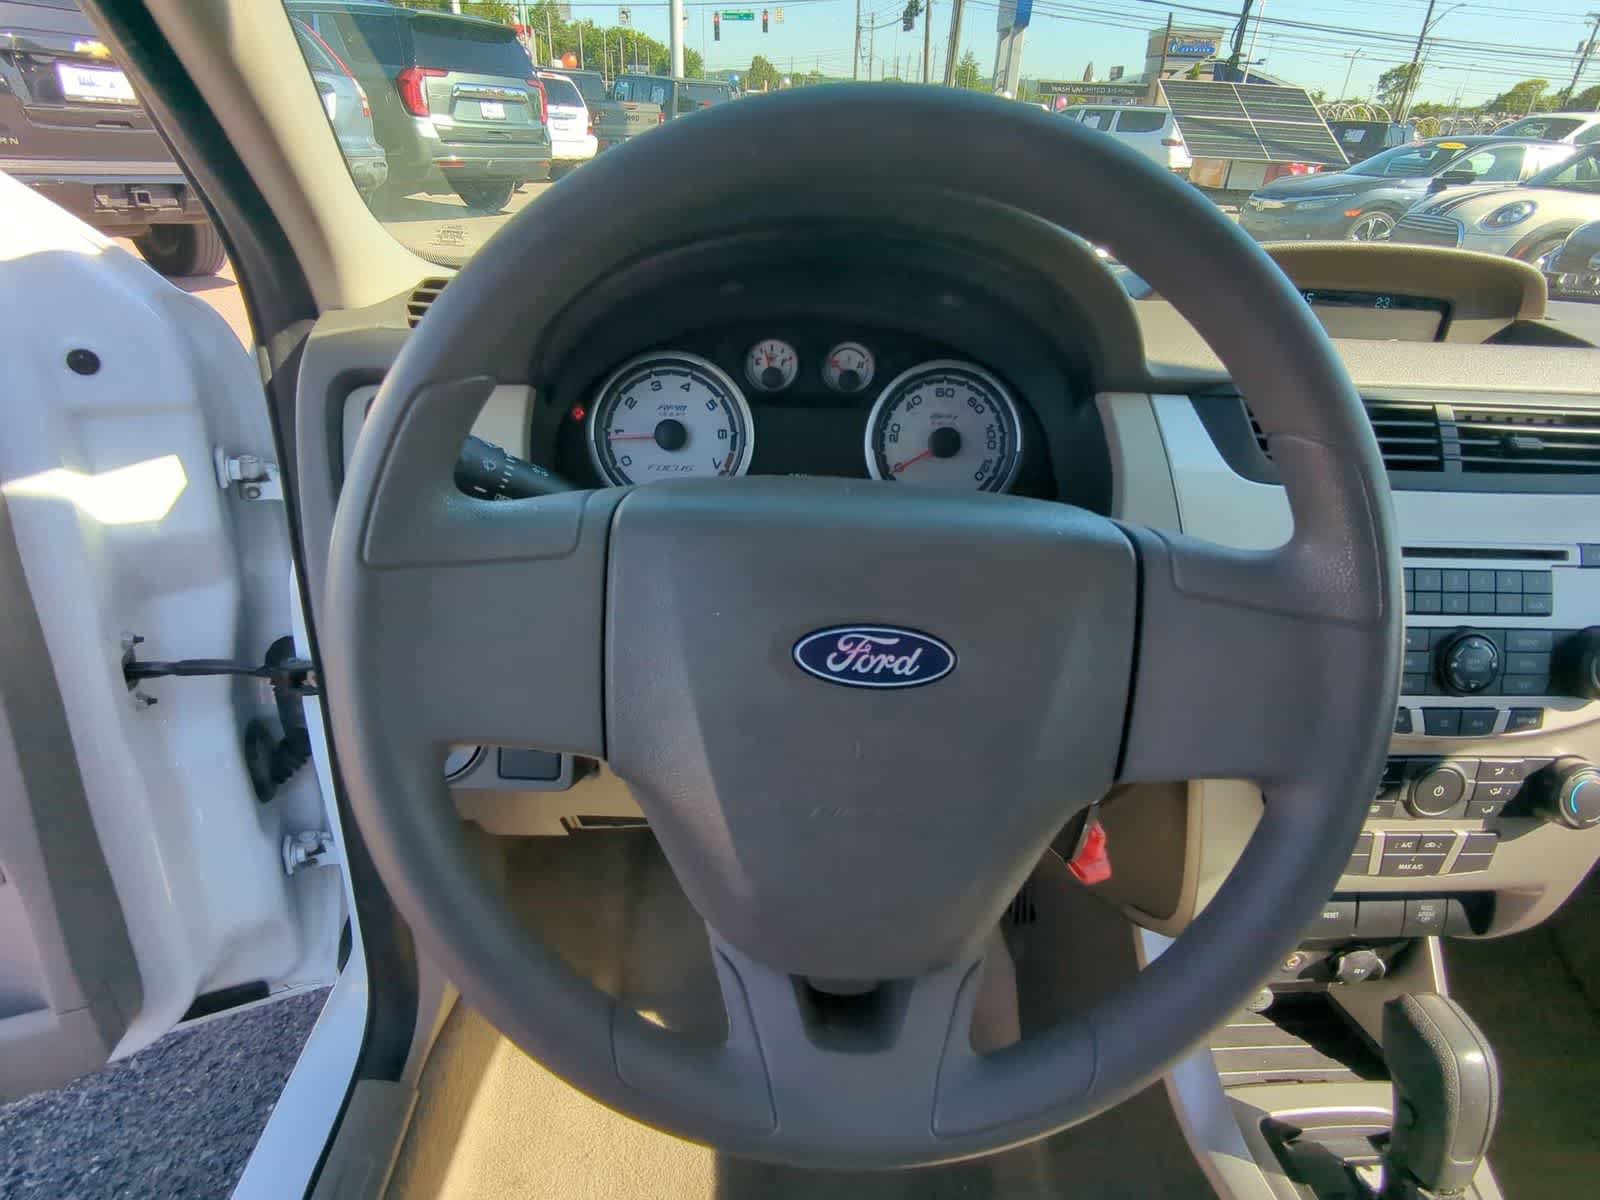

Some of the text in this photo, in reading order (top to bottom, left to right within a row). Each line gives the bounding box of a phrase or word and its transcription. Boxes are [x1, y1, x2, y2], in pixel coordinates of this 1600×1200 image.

[1071, 86, 1105, 94] UNLIMITED
[650, 380, 662, 391] 3
[680, 383, 691, 392] 4
[935, 387, 956, 398] 60
[624, 397, 637, 410] 2
[705, 400, 718, 411] 5
[905, 395, 922, 413] 40
[967, 396, 985, 414] 80
[717, 429, 727, 440] 6
[889, 423, 901, 443] 20
[986, 424, 997, 450] 100
[620, 455, 632, 467] 0
[712, 457, 723, 469] 7
[974, 458, 993, 481] 120
[826, 633, 923, 676] Ford
